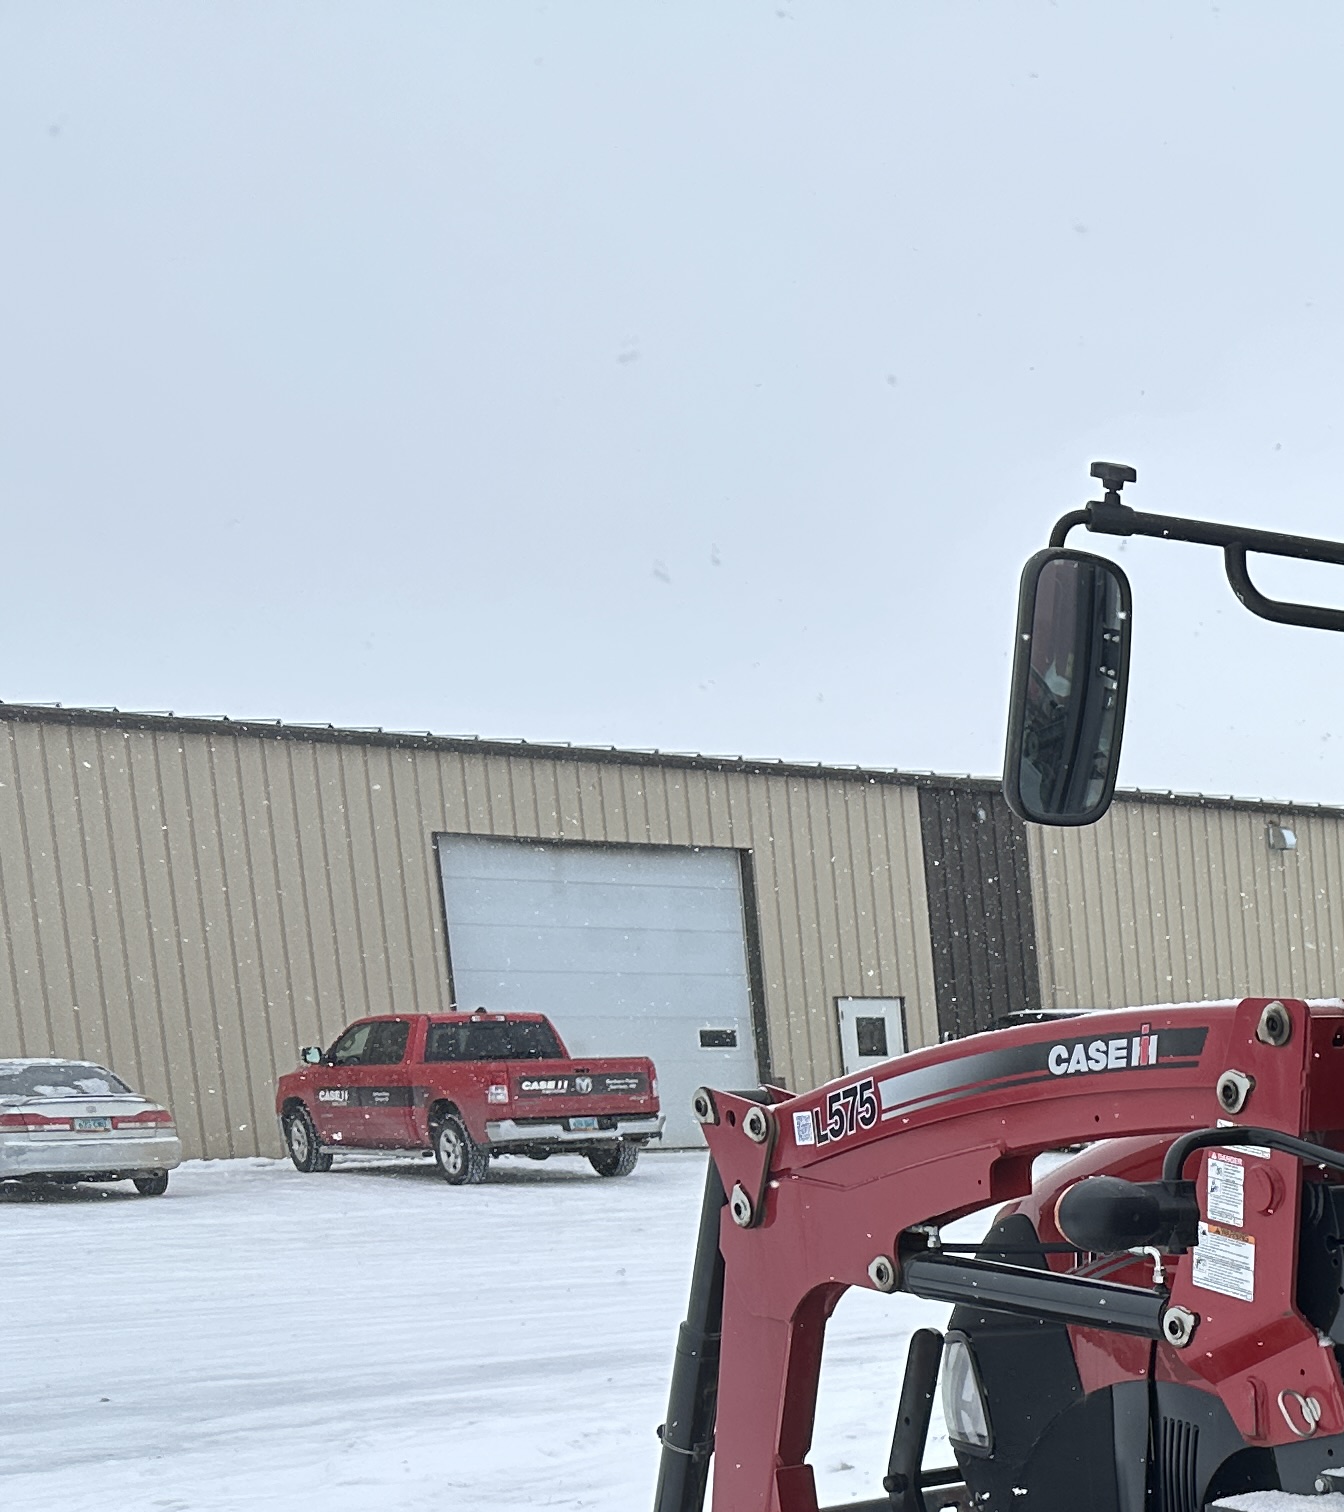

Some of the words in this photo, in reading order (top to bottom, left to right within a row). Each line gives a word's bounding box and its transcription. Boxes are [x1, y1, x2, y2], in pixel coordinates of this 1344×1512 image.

[1048, 1039, 1127, 1075] CASE
[319, 1090, 340, 1101] CASE
[522, 1080, 554, 1091] CASE
[813, 1076, 878, 1147] L575
